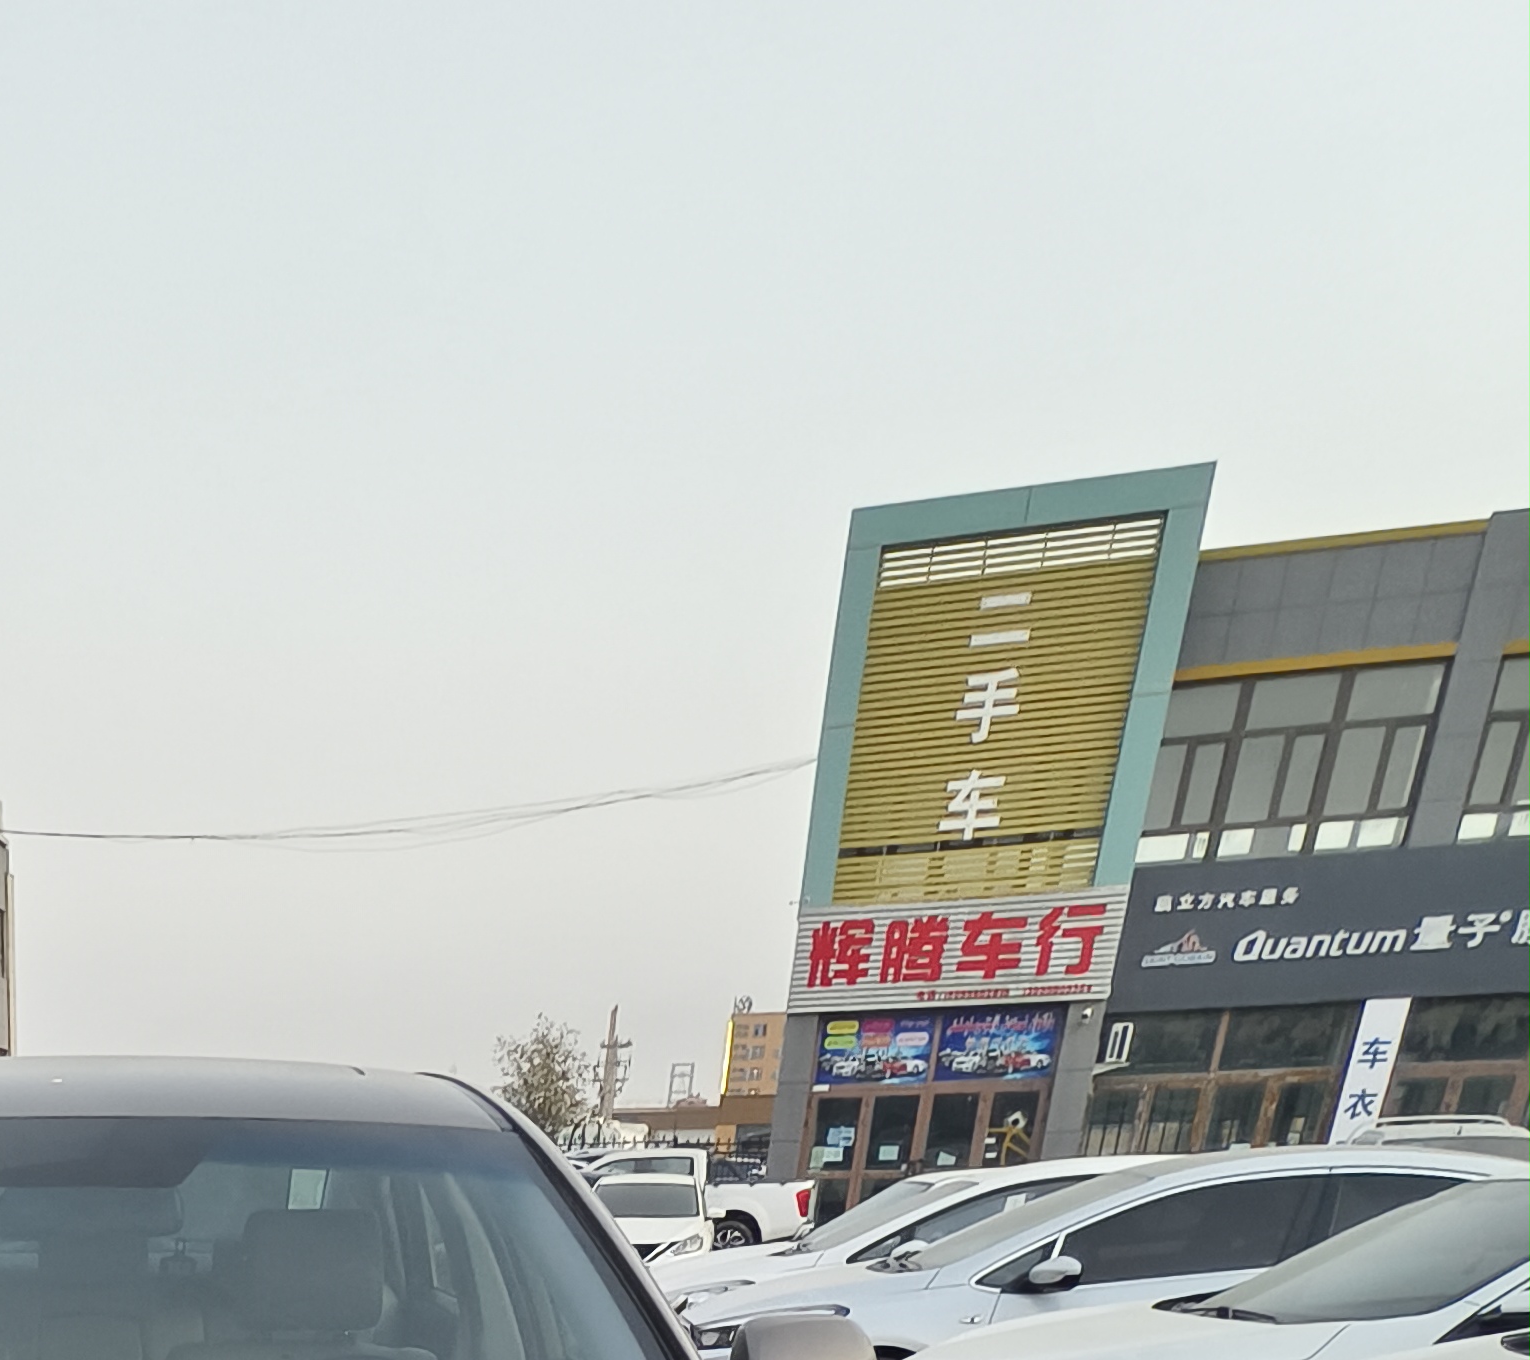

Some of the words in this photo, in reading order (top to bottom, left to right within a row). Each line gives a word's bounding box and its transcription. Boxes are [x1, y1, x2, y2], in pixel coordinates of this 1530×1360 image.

[938, 592, 1032, 841] 二手车
[806, 904, 1107, 988] 辉腾车行
[1232, 928, 1408, 962] Quantum
[1344, 1037, 1392, 1120] 车衣
